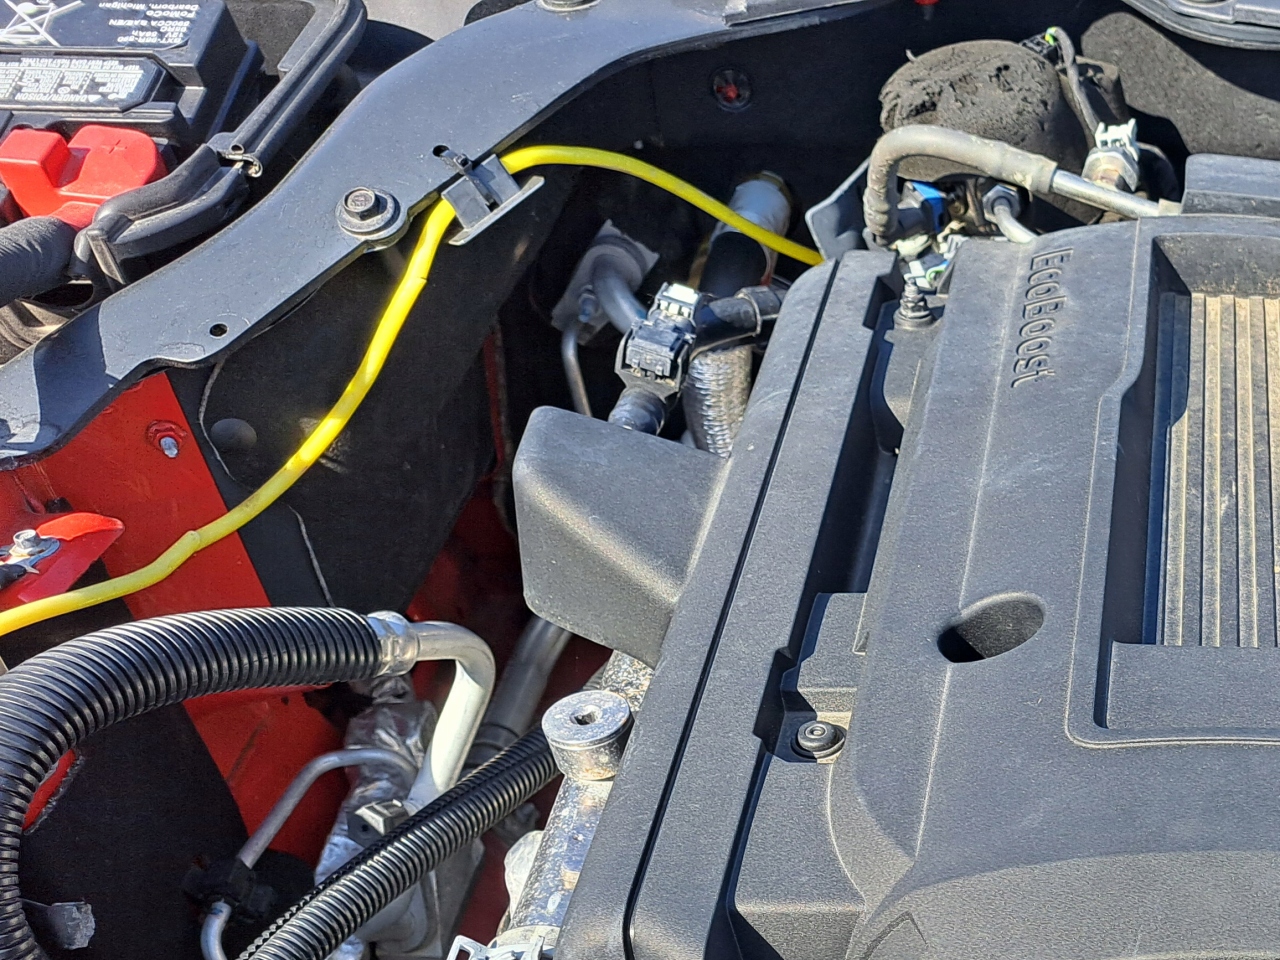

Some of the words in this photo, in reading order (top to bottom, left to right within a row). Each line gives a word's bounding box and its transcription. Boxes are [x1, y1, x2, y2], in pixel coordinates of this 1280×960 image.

[98, 2, 146, 11] Michigan
[145, 10, 197, 18] FoMoCo
[14, 93, 88, 103] DANGER/POISON
[1010, 248, 1074, 388] EcoBoost
